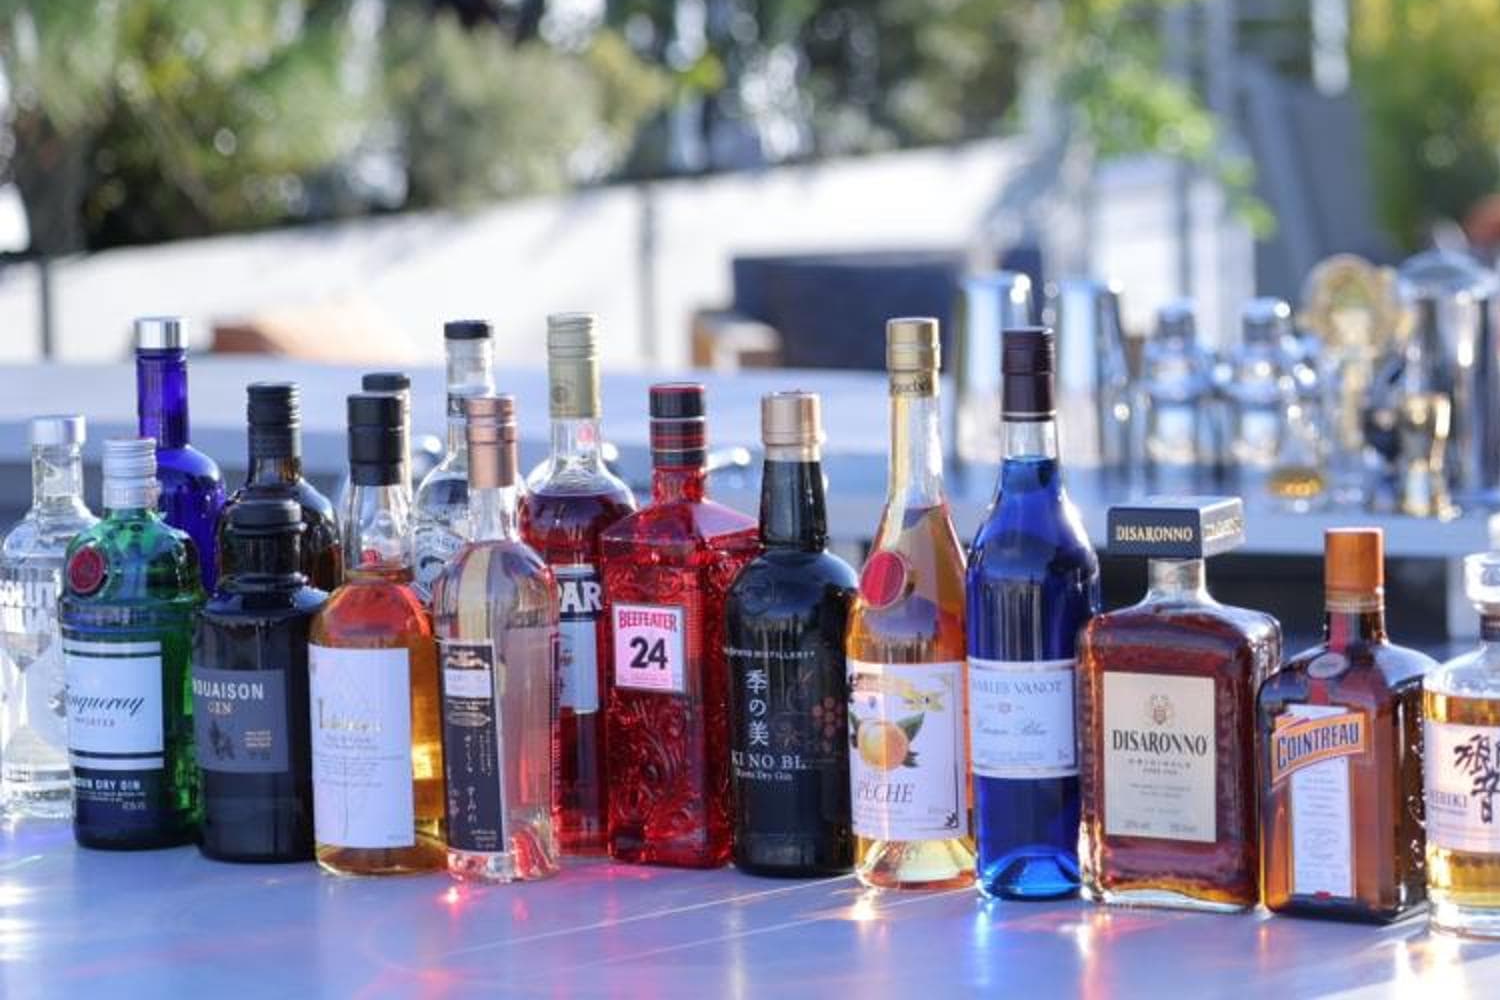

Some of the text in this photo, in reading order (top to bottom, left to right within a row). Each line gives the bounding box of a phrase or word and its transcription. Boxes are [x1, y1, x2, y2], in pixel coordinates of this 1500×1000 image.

[1115, 525, 1194, 542] DISARONNO
[618, 609, 678, 632] BEEFEATER
[629, 635, 669, 670] 24
[207, 701, 232, 714] GIN
[745, 668, 770, 746] 季の美
[1112, 729, 1208, 757] DISARONNO
[1277, 722, 1360, 769] COINTREAU
[749, 754, 774, 769] NO
